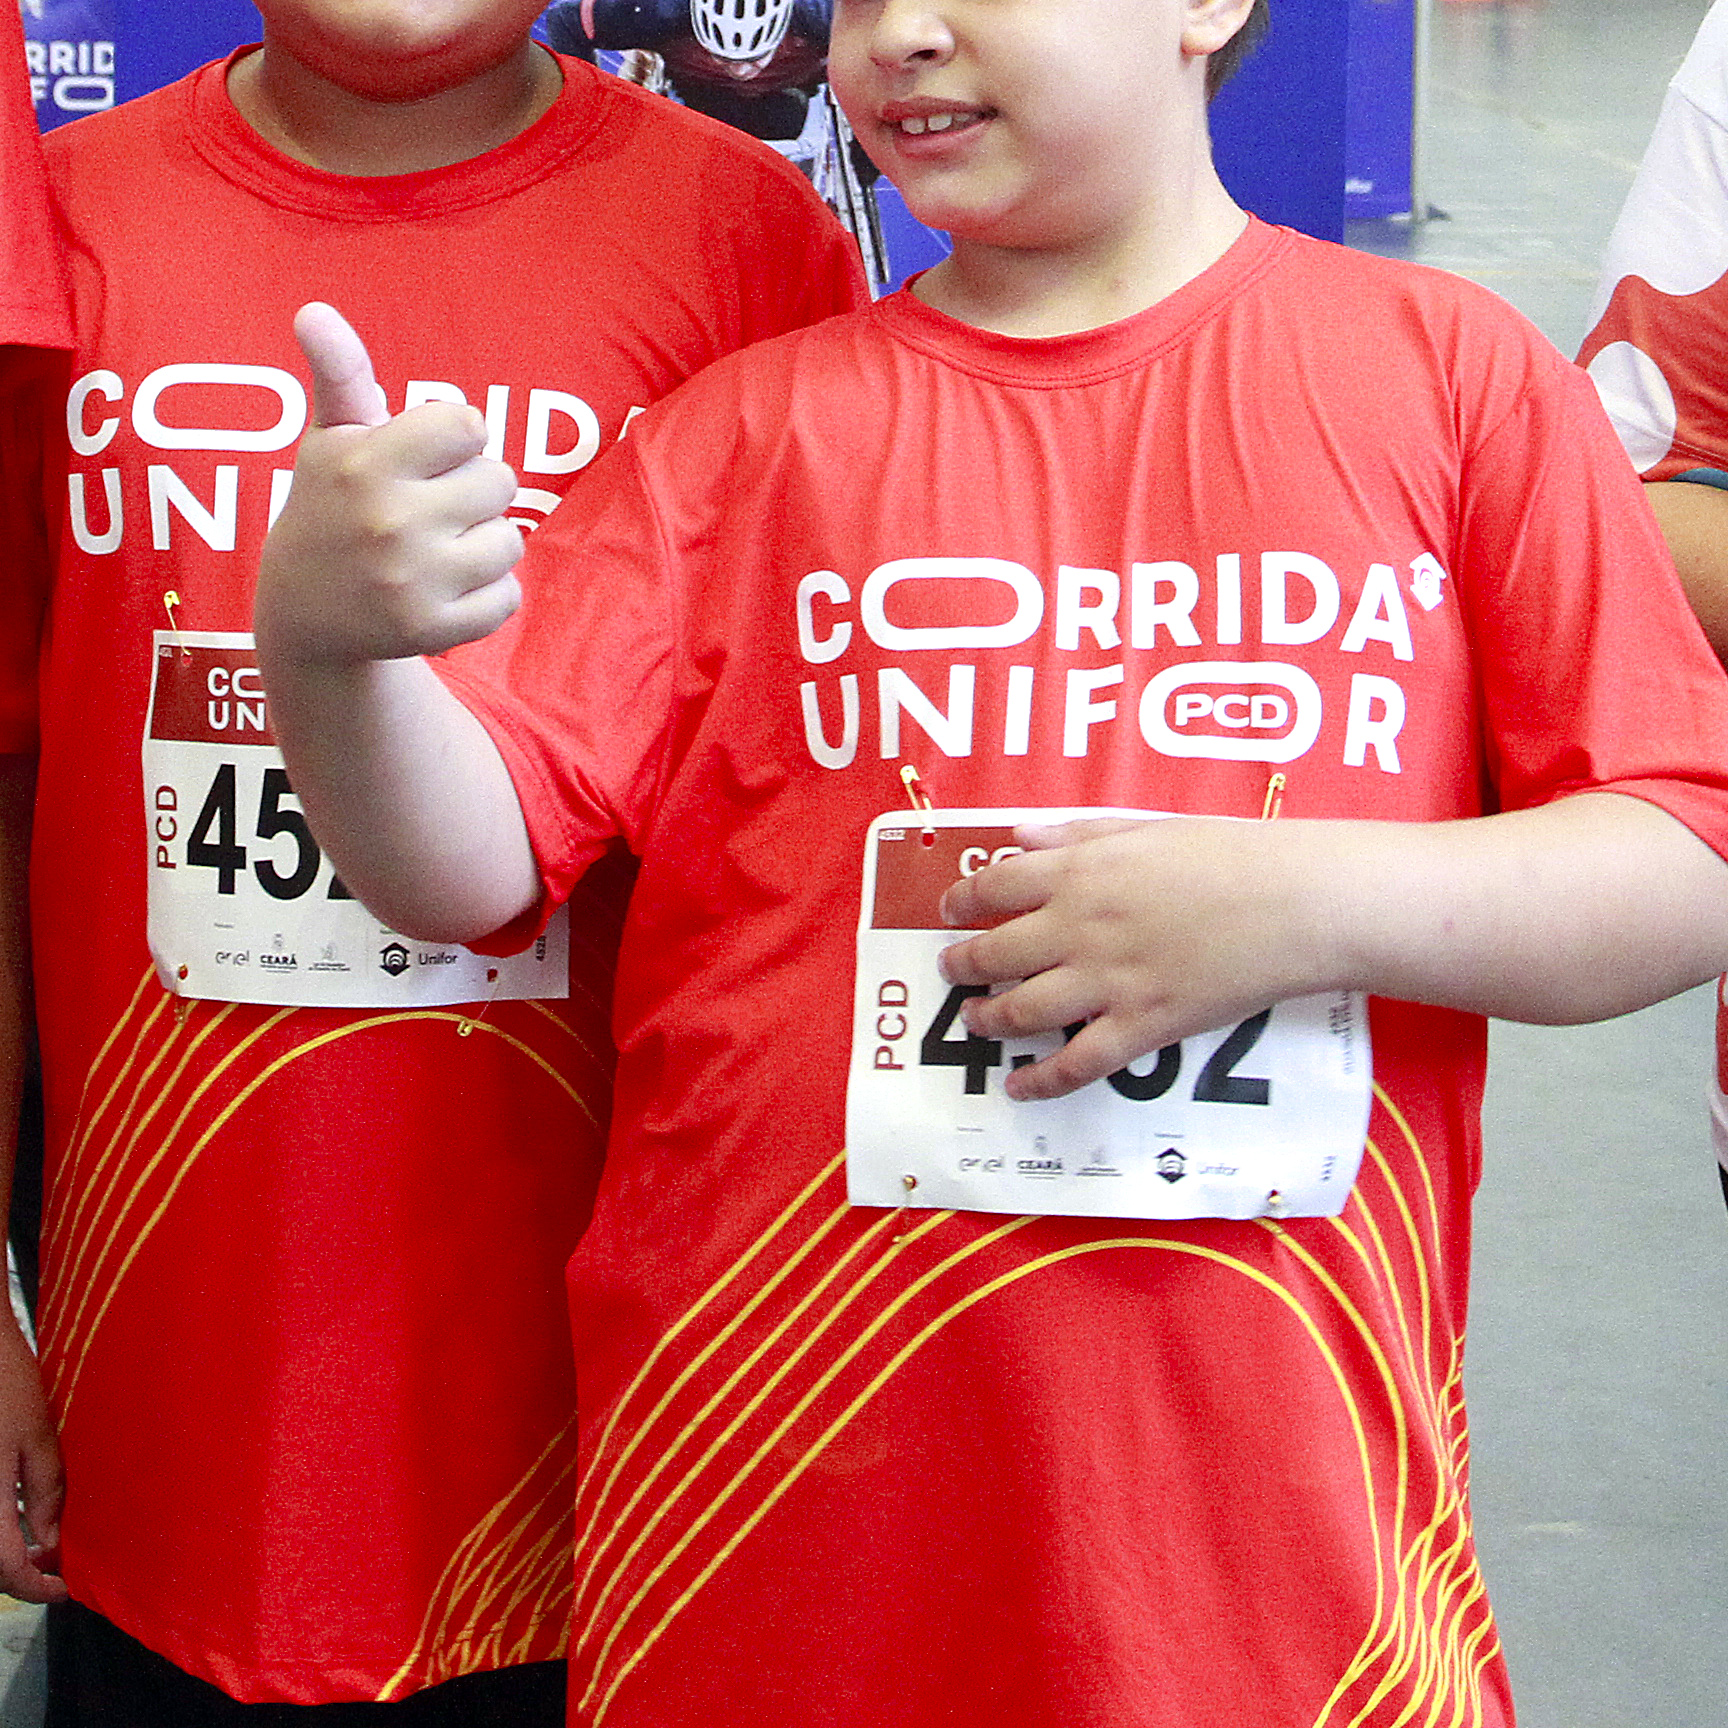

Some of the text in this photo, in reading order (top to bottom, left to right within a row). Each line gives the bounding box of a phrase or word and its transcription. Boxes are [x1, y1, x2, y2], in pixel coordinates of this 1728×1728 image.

[795, 550, 1415, 664] CORRIDA
[798, 660, 1408, 775] UNIFOR
[1174, 692, 1290, 729] PCD
[155, 784, 178, 870] PCD
[186, 763, 358, 902] 45
[418, 951, 460, 966] Unifor
[875, 979, 909, 1072] PCD
[919, 983, 1274, 1106] 42
